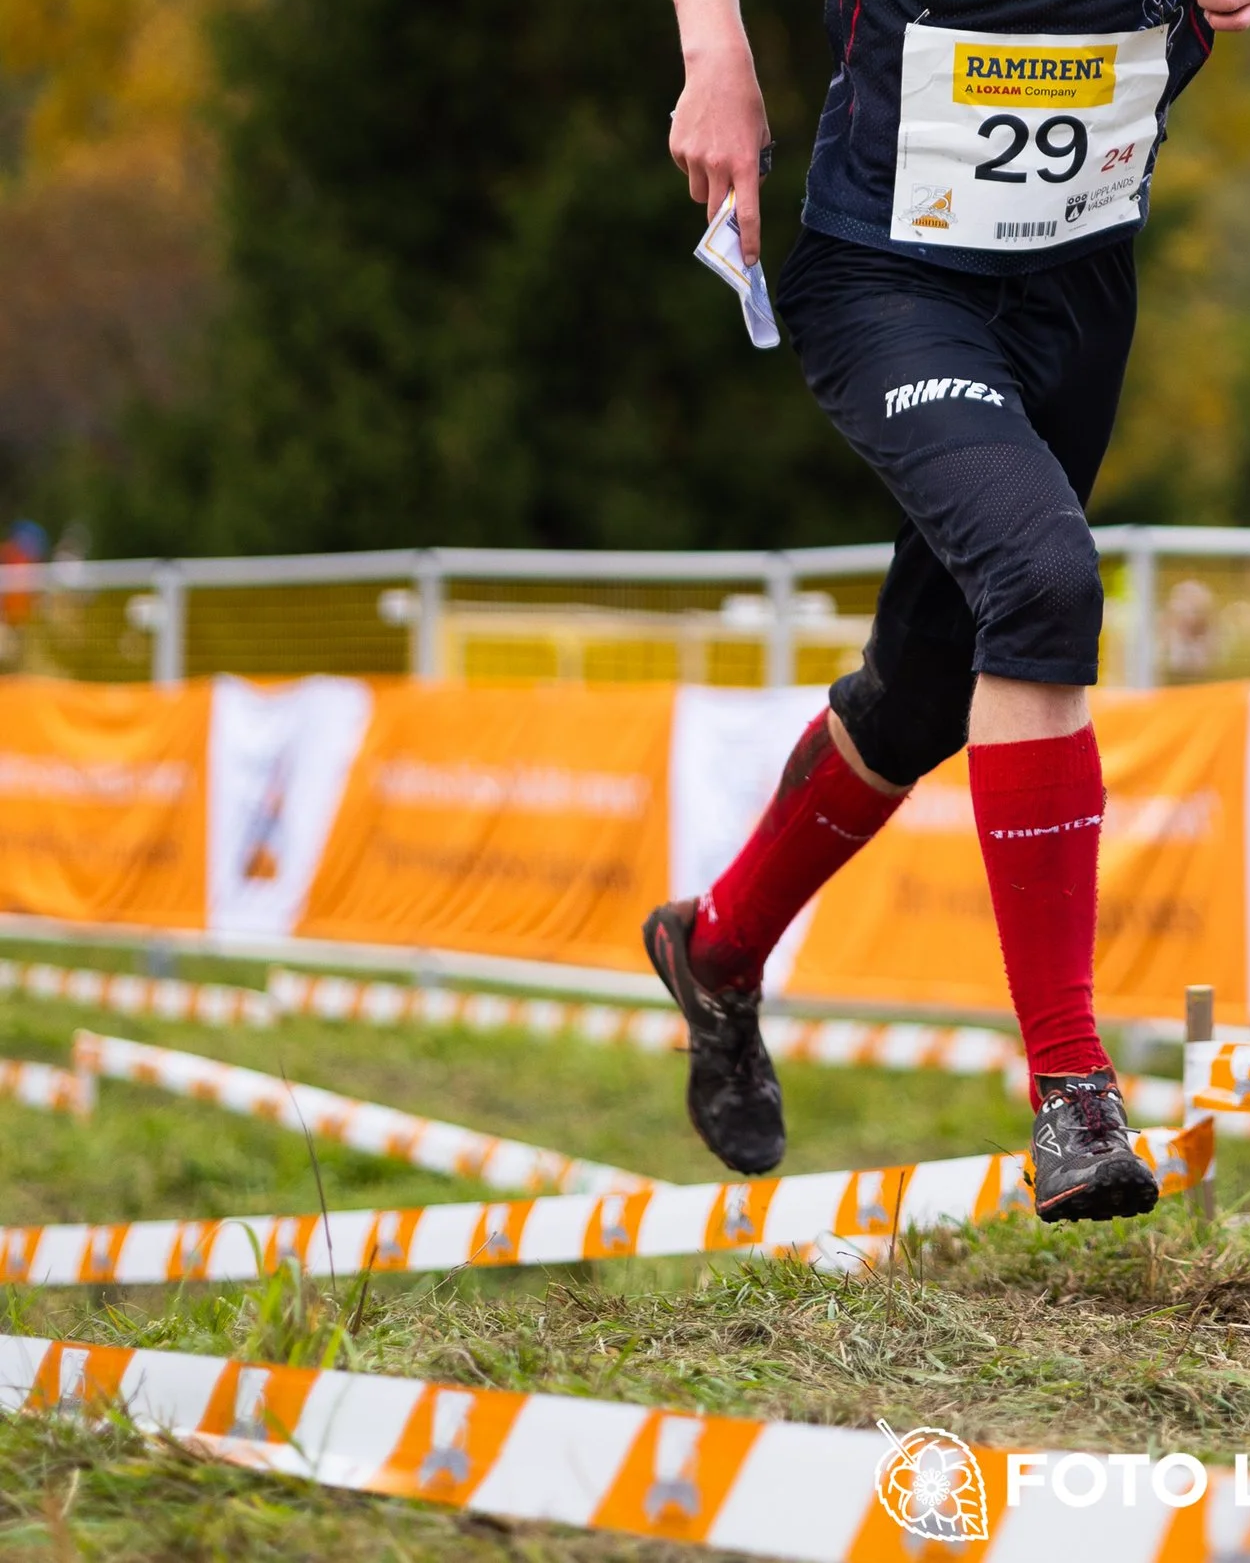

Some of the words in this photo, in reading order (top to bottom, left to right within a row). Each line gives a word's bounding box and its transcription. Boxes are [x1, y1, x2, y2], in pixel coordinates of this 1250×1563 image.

[966, 56, 1104, 81] RAMIRENT
[965, 84, 974, 94] A
[976, 85, 1022, 95] LOXAM
[1024, 86, 1077, 98] Company
[974, 113, 1088, 184] 29
[1100, 142, 1136, 173] 24
[1090, 176, 1135, 201] UPPLANDS
[885, 378, 1005, 418] TRIMTEX
